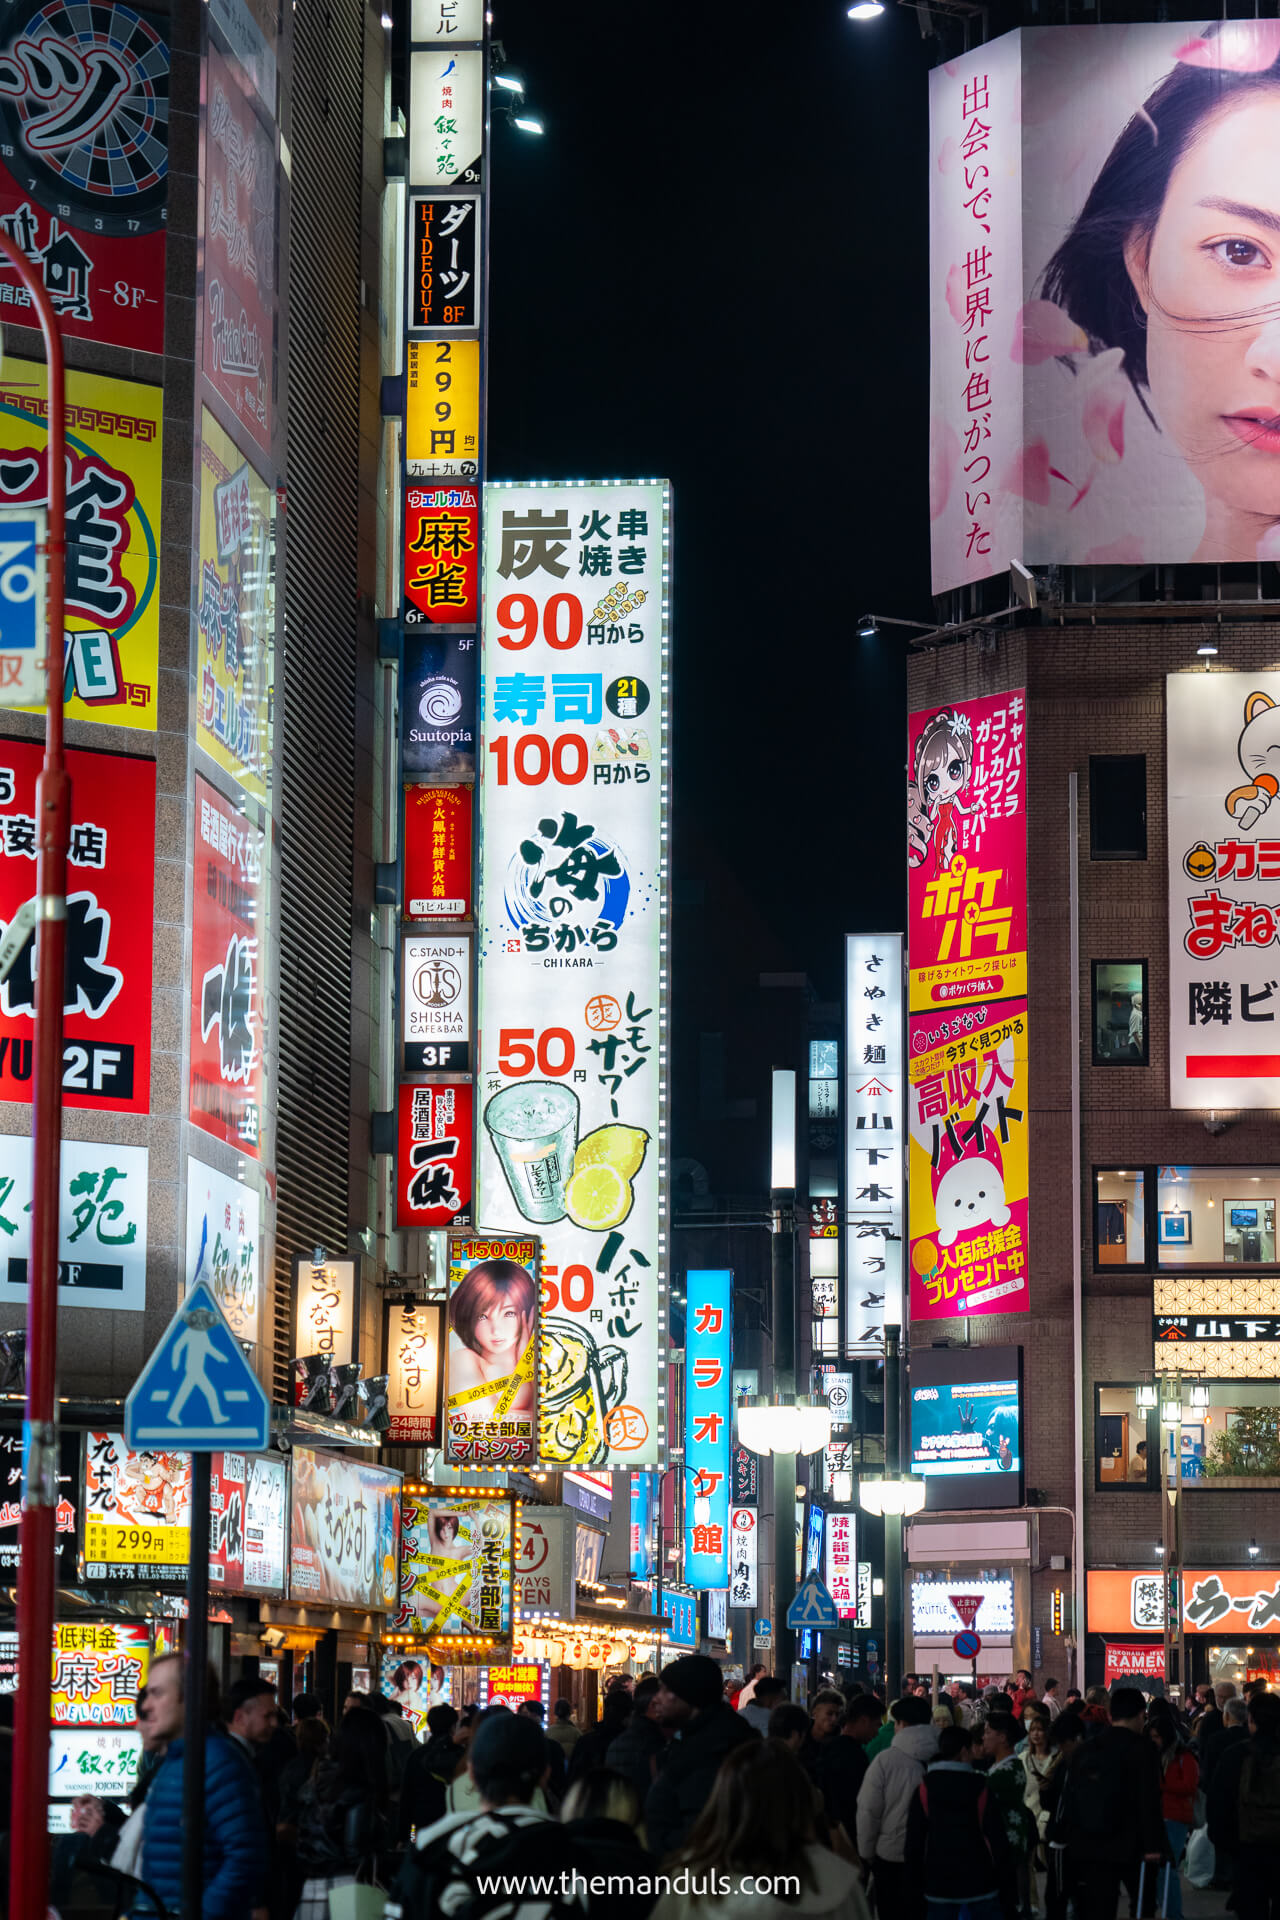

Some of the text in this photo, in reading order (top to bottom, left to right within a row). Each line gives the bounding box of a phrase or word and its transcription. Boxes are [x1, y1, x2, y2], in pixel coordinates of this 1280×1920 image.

[436, 1, 458, 34] ビル
[441, 86, 452, 109] 焼肉
[433, 115, 458, 175] 叙々苑
[28, 180, 37, 190] 7
[464, 168, 480, 183] 9F
[95, 219, 103, 230] 3
[420, 204, 434, 324] HIDEOUT
[438, 203, 473, 300] ダーツ
[443, 305, 465, 323] 8F
[960, 75, 993, 559] 出会いで、世界に色がついた
[430, 342, 456, 454] 299円
[464, 435, 475, 452] 均一
[411, 463, 475, 477] 九十九 7F
[408, 490, 478, 508] ウェルカム
[408, 511, 475, 608] 麻雀
[497, 509, 572, 580] 炭
[405, 609, 425, 624] 6F
[497, 593, 645, 651] 90 円から
[458, 639, 474, 651] 5F
[493, 672, 603, 726] 寿司
[617, 680, 638, 697] 21
[409, 728, 472, 746] Suutopia
[489, 733, 651, 786] 100 円から
[989, 709, 1007, 819] コンカフェ
[1006, 696, 1024, 818] キャバクラ
[970, 720, 992, 853] ガールズバー
[962, 819, 970, 850] 探しは
[522, 921, 619, 954] ちから
[1185, 890, 1280, 957] まね
[410, 947, 465, 957] C.STAND+
[543, 958, 593, 968] CHIKARA
[410, 1011, 463, 1023] SHISHA
[863, 954, 887, 1065] さぬき麺
[927, 1005, 989, 1044] いちごなび
[622, 990, 653, 1078] レモン
[945, 1018, 1025, 1063] 今すぐ見つかる
[62, 1046, 121, 1090] 2F
[422, 1046, 451, 1066] 3F
[498, 1027, 587, 1083] 50 円
[586, 1034, 626, 1118] サワー
[914, 1048, 1015, 1126] 高収入
[412, 1090, 431, 1140] 居酒屋
[930, 1095, 1024, 1170] バイト
[453, 1216, 470, 1226] 2F
[825, 1227, 838, 1238] 4F
[463, 1240, 535, 1259] 1500円
[939, 1223, 1022, 1275] 入店応援金
[595, 1231, 652, 1339] ハイボール
[926, 1249, 1025, 1306] プレゼント中
[589, 1308, 604, 1323] 円
[399, 1314, 430, 1409] きづなすし
[388, 1429, 434, 1441] 年中無休
[391, 1417, 432, 1428] 24時間
[452, 1421, 532, 1438] のぞき部屋
[691, 1304, 723, 1555] カラオケ館
[831, 1424, 844, 1432] 4F
[451, 1440, 531, 1461] マドンナ
[89, 1439, 119, 1512] 九十九
[117, 1530, 164, 1551] 299円
[480, 1518, 504, 1632] のぞき部屋
[832, 1576, 850, 1600] 火鍋
[858, 1584, 868, 1627] ルノアール
[957, 1599, 977, 1607] 止まれ
[60, 1626, 117, 1649] 低料金
[488, 1667, 539, 1682] 24H営業
[1107, 1655, 1165, 1668] RAMEN
[51, 1655, 142, 1701] 麻雀
[54, 1703, 136, 1722] WELCOME
[97, 1736, 122, 1748] 焼肉
[76, 1748, 137, 1776] 叙々苑
[95, 1782, 124, 1792] JOJOEN
